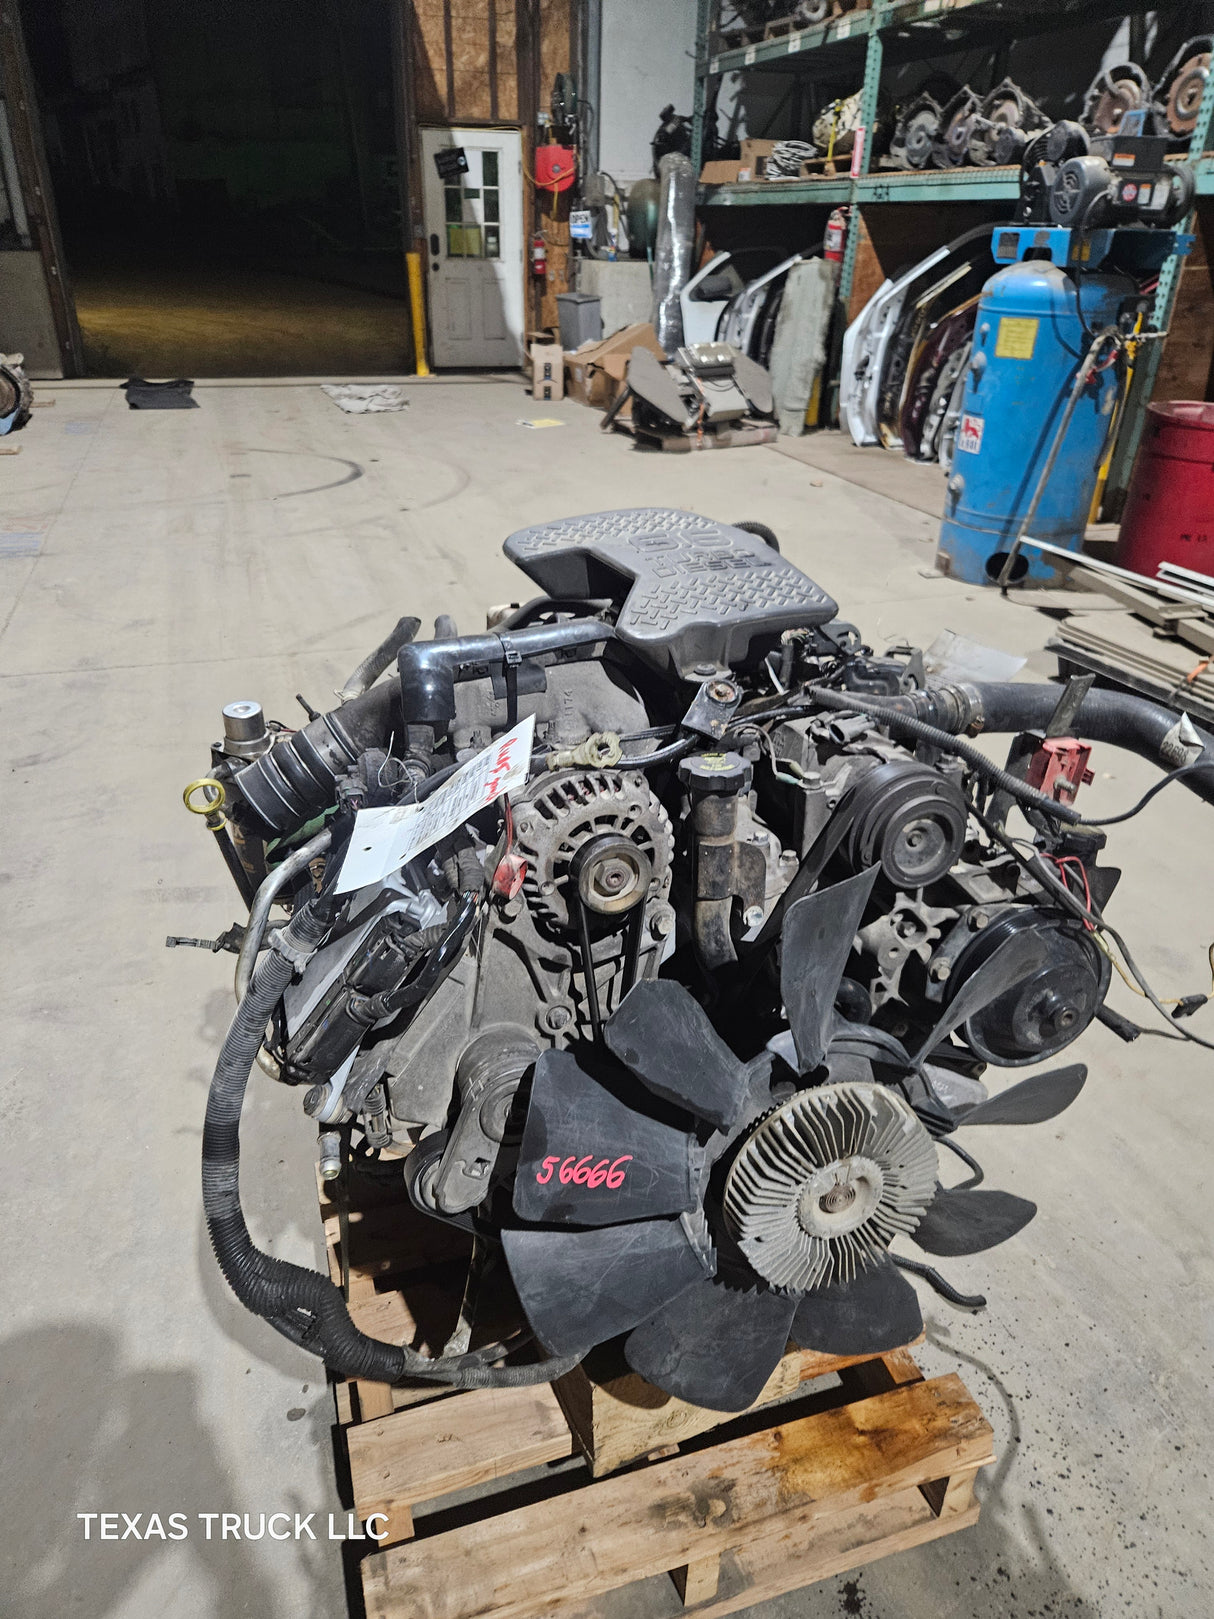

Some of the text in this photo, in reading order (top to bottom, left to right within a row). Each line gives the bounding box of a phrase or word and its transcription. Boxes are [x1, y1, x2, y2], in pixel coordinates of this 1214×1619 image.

[645, 548, 756, 567] TURBO
[651, 558, 773, 578] DIESEL
[536, 1154, 634, 1189] 56666
